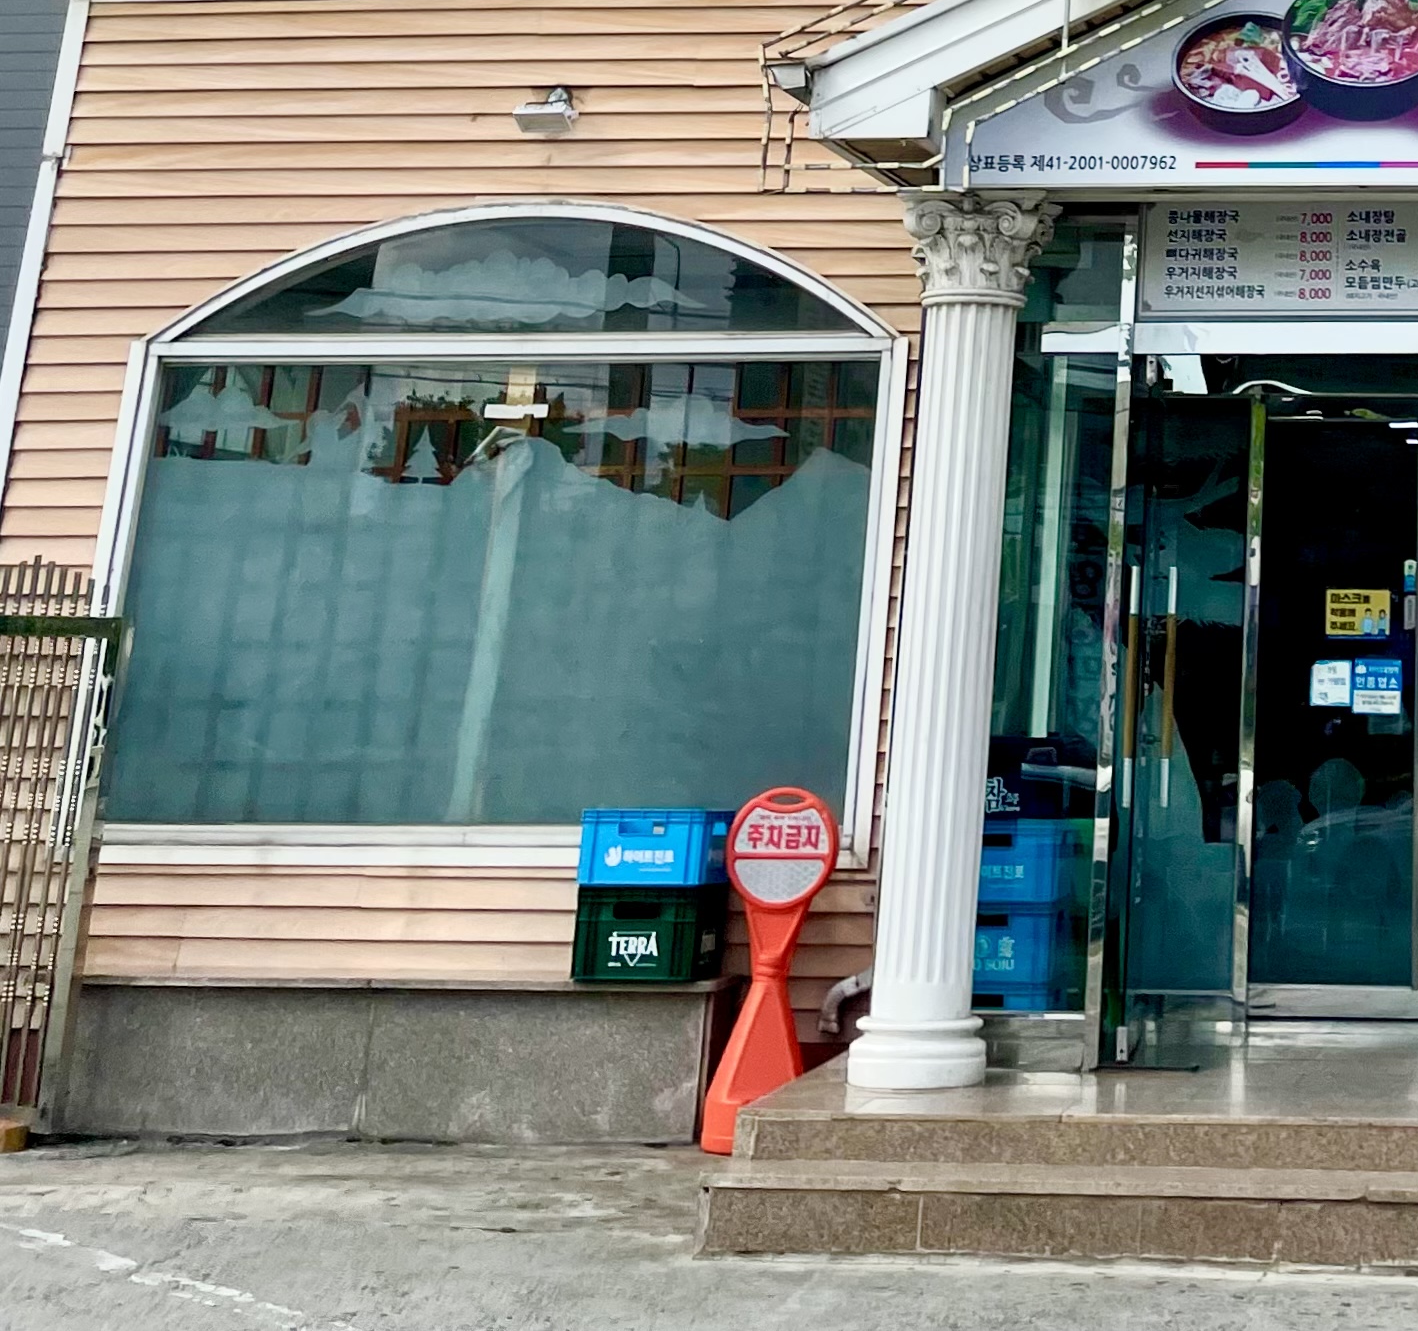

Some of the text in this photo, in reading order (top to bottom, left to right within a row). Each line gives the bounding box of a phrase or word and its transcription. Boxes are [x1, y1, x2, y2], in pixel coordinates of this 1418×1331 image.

[969, 154, 1177, 172] 상표등록 제41-2001-0007962
[1300, 212, 1333, 226] 7,000
[1346, 210, 1395, 224] 소내장탕
[1167, 229, 1227, 243] 선지해장국
[1300, 231, 1333, 244] 8,000
[1299, 250, 1333, 263] 8,000
[1165, 266, 1239, 280] 우거지해장국
[1299, 269, 1332, 282] 7,000
[1298, 288, 1332, 300] 8,000
[748, 824, 821, 850] 주차금지
[608, 931, 659, 957] TERRA
